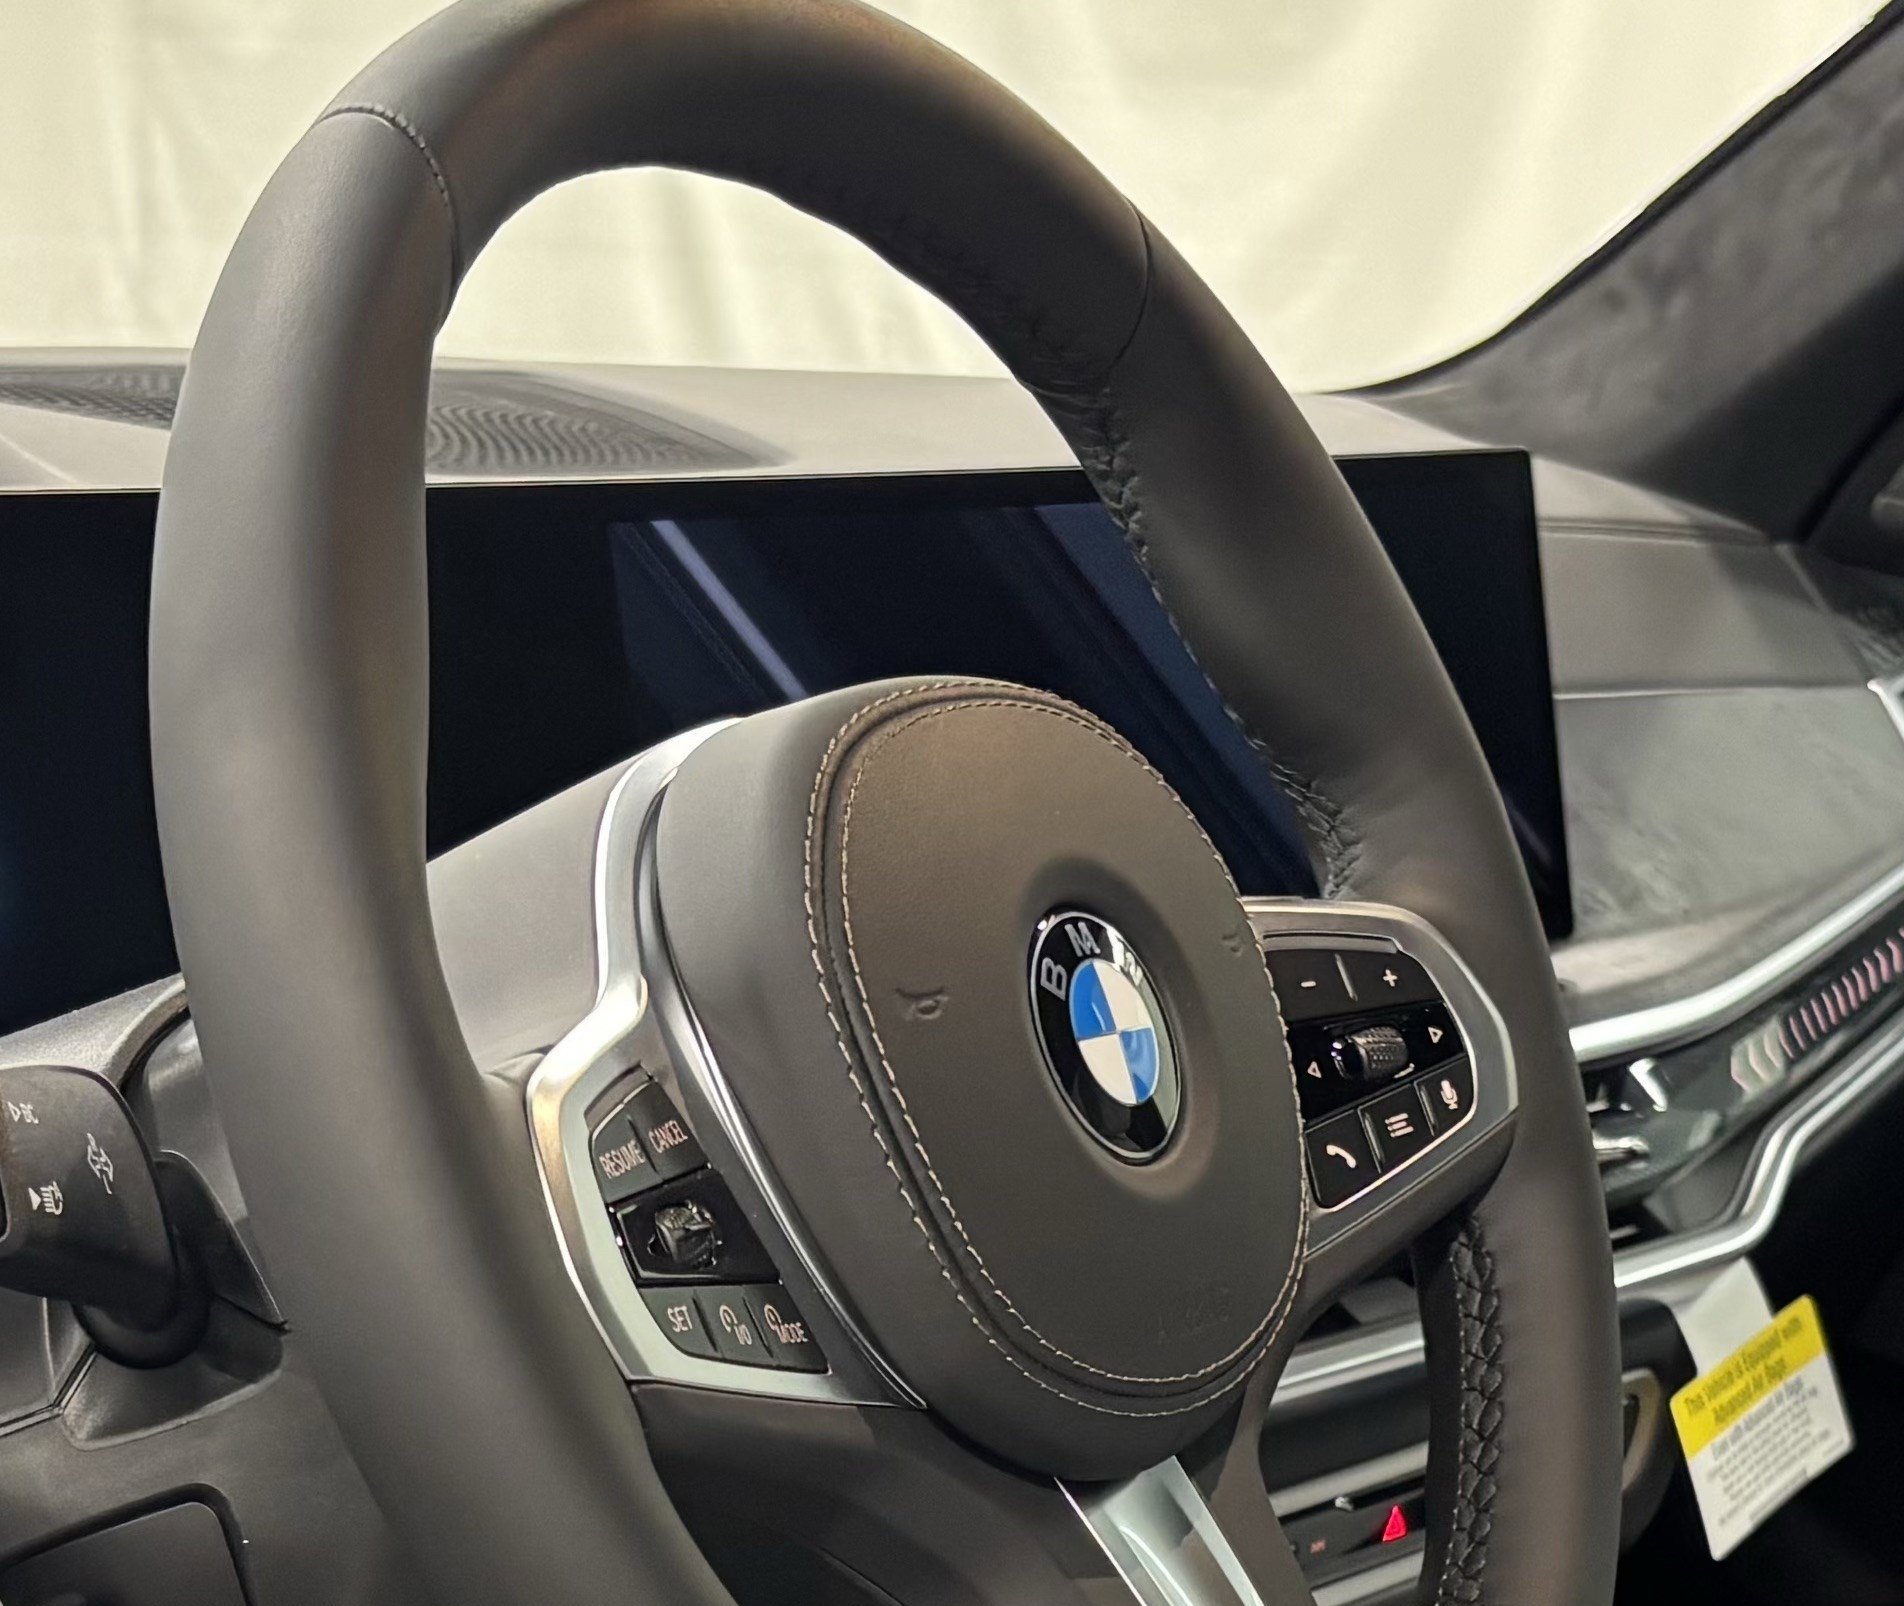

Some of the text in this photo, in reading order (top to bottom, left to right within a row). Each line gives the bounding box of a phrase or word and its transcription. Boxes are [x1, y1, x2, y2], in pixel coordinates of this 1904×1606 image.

[1040, 921, 1144, 1001] BMW
[648, 1119, 688, 1154] CANCEL
[599, 1138, 645, 1180] RESUME
[667, 1305, 693, 1333] SET
[777, 1322, 808, 1344] MODE
